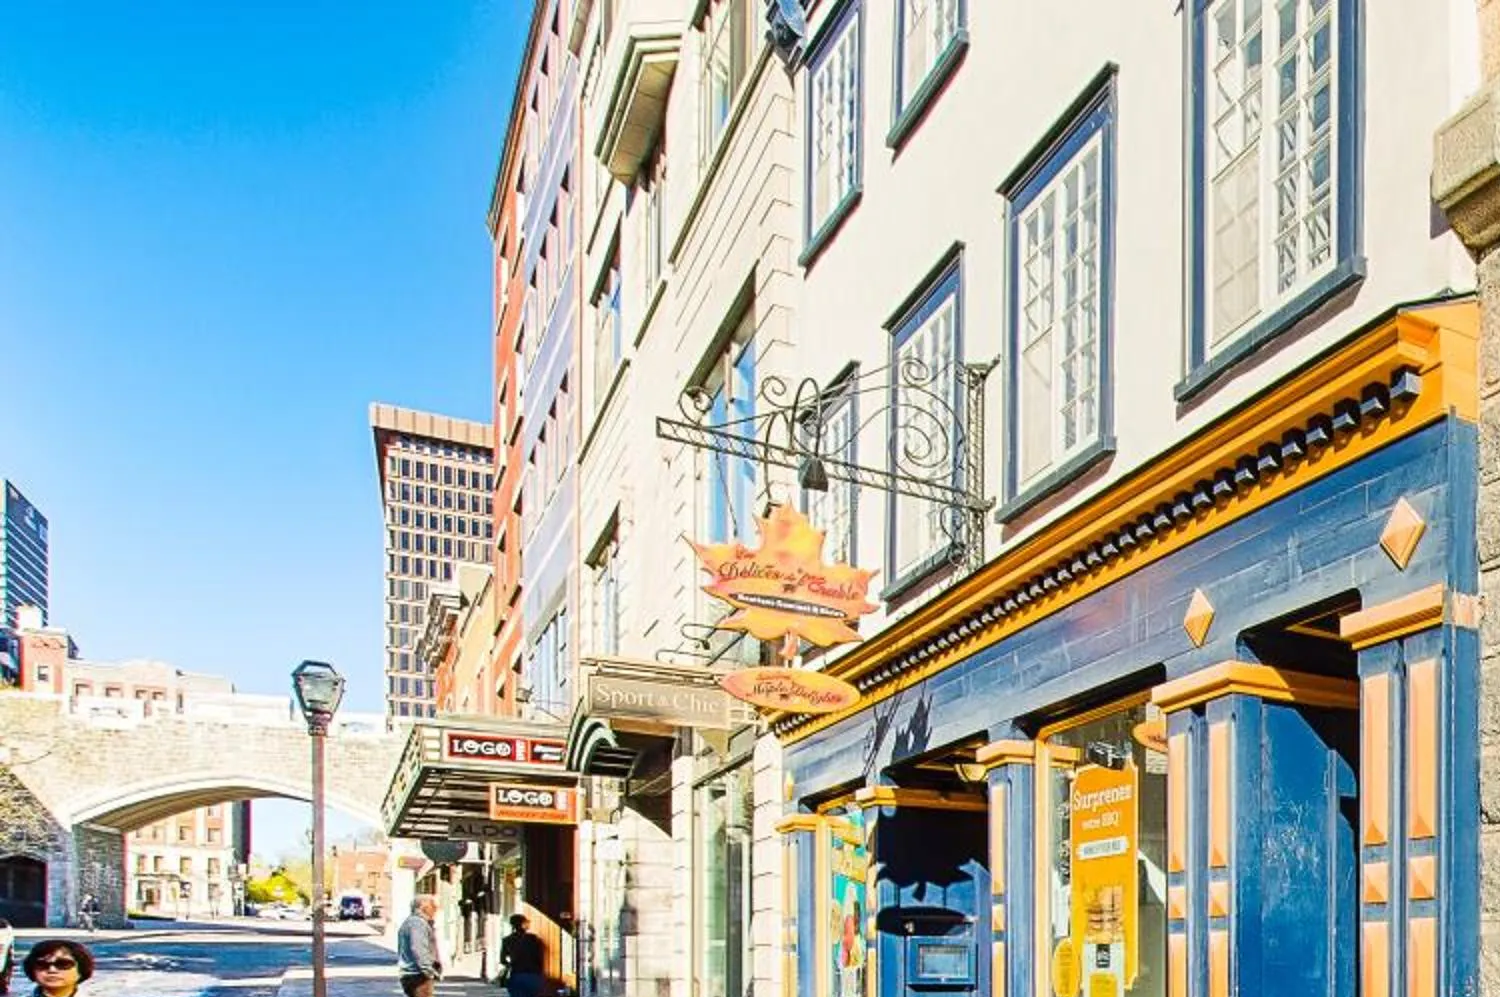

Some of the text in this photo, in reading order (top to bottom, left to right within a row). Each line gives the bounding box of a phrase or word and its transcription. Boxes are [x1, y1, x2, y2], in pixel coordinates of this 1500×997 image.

[596, 682, 654, 709] Sport
[672, 692, 719, 714] Chic
[451, 738, 512, 757] LOGO
[497, 788, 553, 807] LOGO
[452, 823, 518, 837] ALDO
